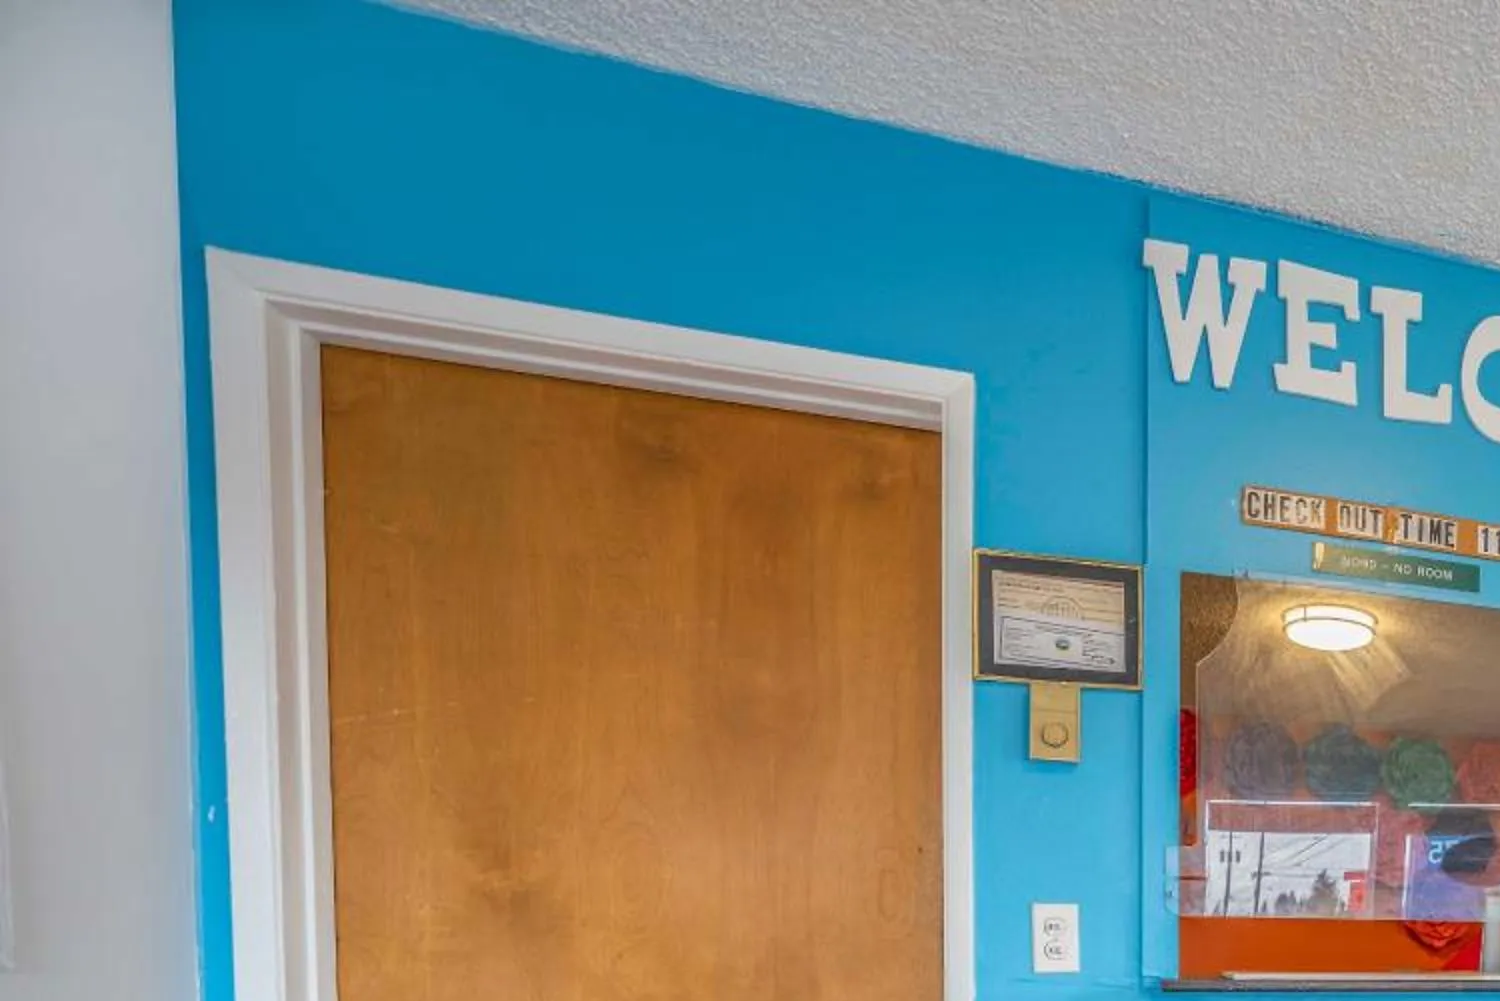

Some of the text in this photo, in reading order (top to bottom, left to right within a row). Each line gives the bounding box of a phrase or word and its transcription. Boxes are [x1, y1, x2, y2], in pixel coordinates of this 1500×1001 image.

[1246, 490, 1323, 524] CHECK
[1340, 504, 1384, 534] OUT
[1400, 512, 1456, 548] TIME
[1392, 562, 1412, 576] NO
[1417, 565, 1453, 582] ROOM
